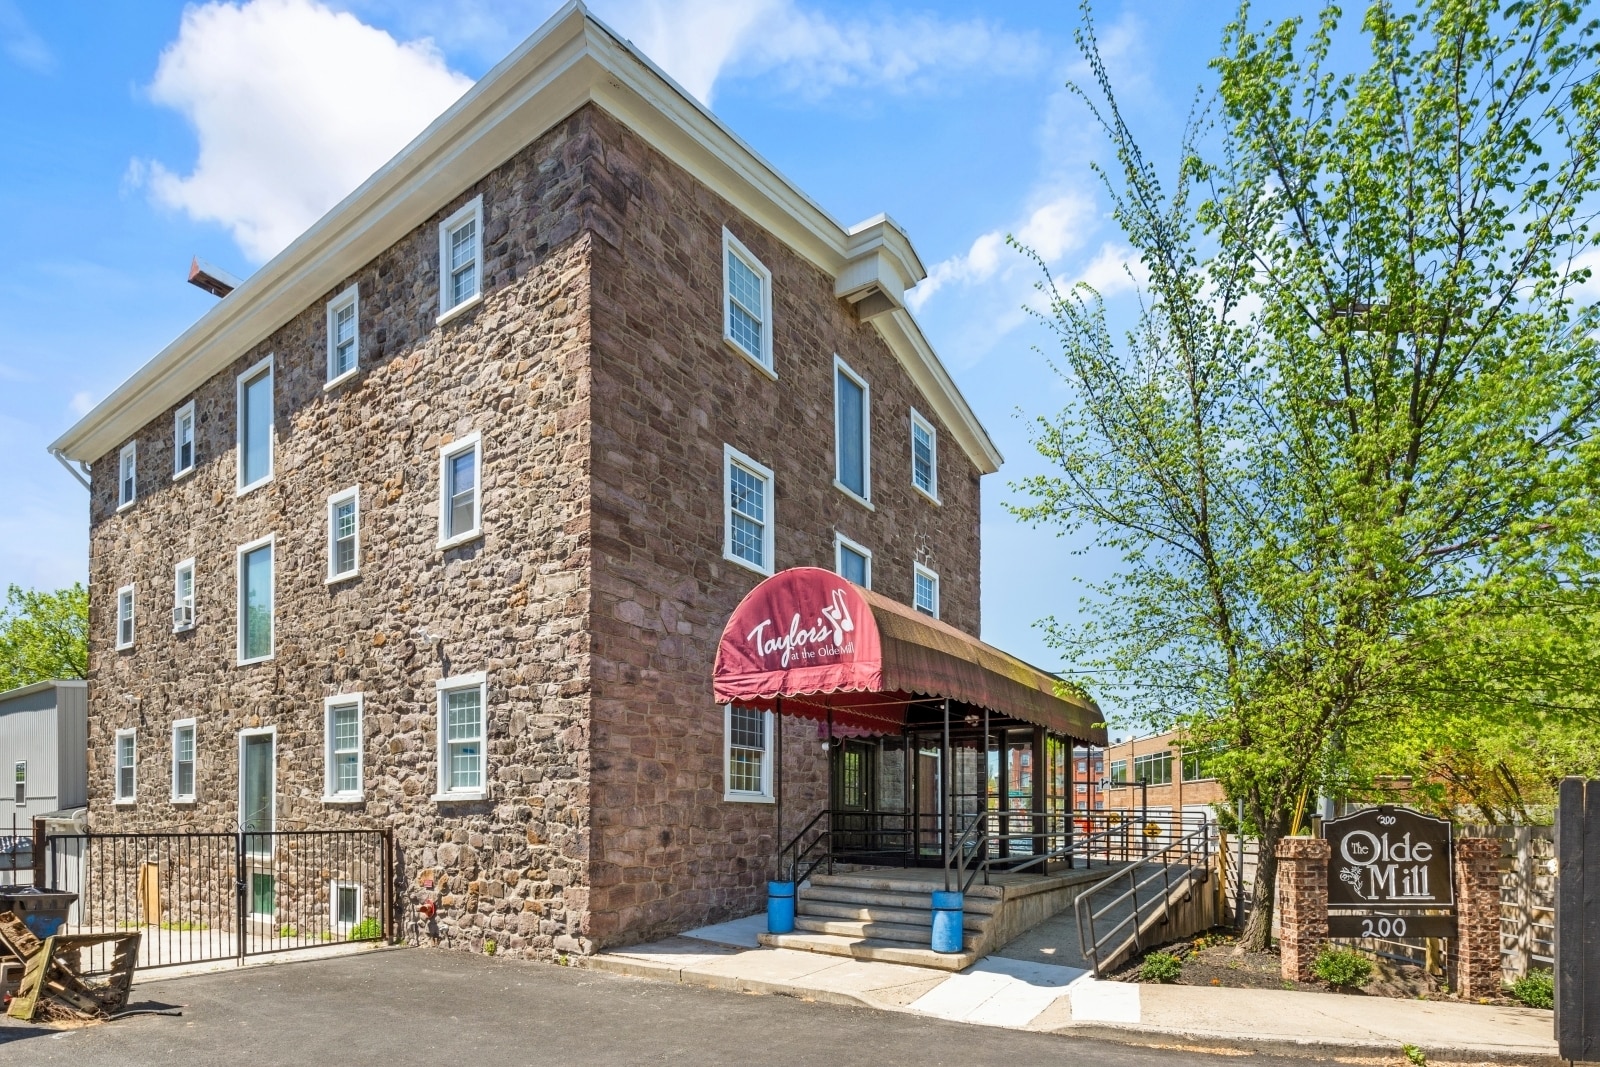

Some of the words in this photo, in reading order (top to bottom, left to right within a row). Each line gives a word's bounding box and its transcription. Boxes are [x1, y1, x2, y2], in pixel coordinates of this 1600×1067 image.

[747, 613, 833, 668] Taylor's
[791, 652, 799, 660] at
[801, 647, 815, 659] the
[818, 644, 840, 657] Olde
[840, 641, 855, 654] Mill
[1340, 830, 1433, 866] Olde
[1351, 841, 1369, 855] The
[1366, 864, 1435, 900] Mill
[1361, 918, 1407, 938] 200
